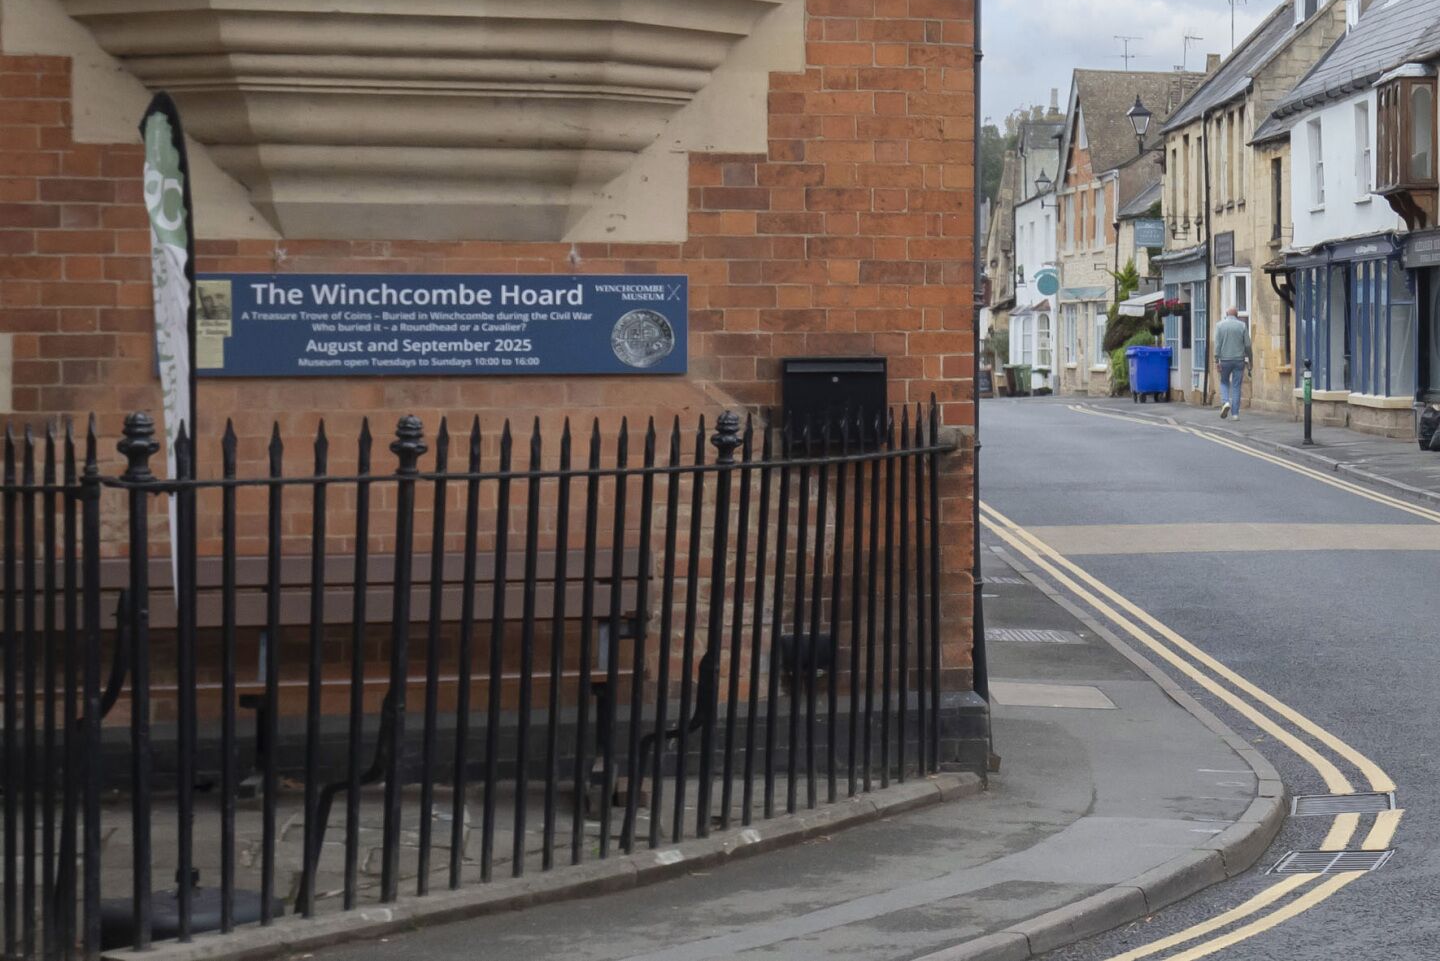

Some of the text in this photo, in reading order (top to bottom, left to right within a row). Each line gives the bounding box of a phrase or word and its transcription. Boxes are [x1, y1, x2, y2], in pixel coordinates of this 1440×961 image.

[250, 282, 584, 306] The Winchcombe Hoard
[595, 284, 665, 293] WINCHCOMBE
[621, 292, 665, 301] MUSEUM
[241, 312, 250, 321] A
[251, 312, 298, 321] Treasure
[300, 312, 329, 321] Trove
[331, 311, 343, 321] of
[344, 311, 372, 321] Coins
[382, 311, 416, 321] Buried
[418, 311, 428, 321] in
[429, 311, 495, 321] Winchcombe
[496, 311, 530, 323] during
[531, 311, 548, 321] the
[549, 311, 571, 321] Civil
[572, 312, 593, 321] War
[312, 323, 336, 332] Who
[338, 323, 372, 332] buried
[373, 323, 382, 332] it
[400, 323, 458, 332] Roundhead
[481, 323, 527, 332] Cavalier?
[305, 339, 532, 356] August and September 2025
[298, 357, 541, 368] Museum open Tuesdays to Sundays 10:00 to 16:00
